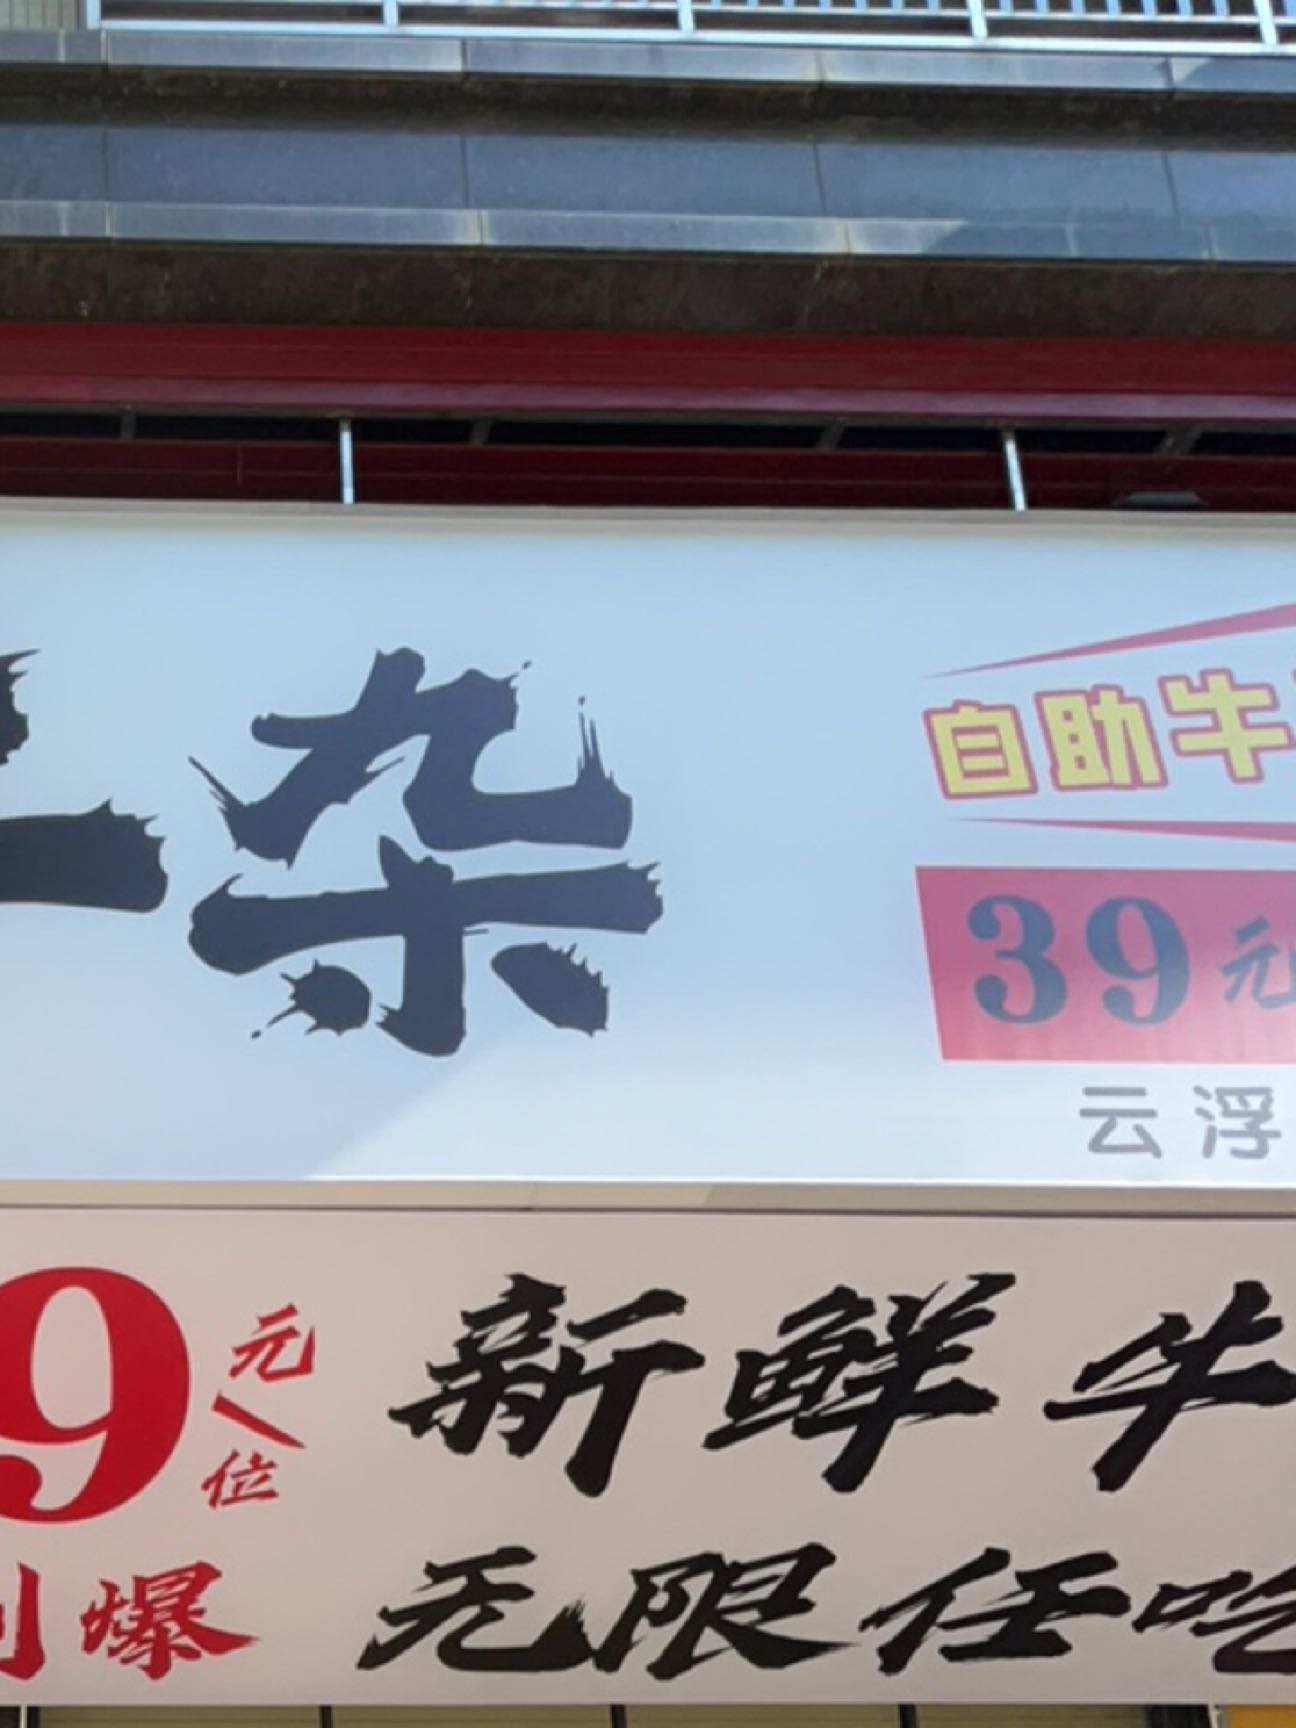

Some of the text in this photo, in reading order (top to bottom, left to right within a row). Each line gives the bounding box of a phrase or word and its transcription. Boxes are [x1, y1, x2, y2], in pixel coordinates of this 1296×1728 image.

[922, 667, 1296, 800] 自助牛
[1079, 1085, 1283, 1160] 云浮
[387, 1272, 1296, 1498] 新鲜牛
